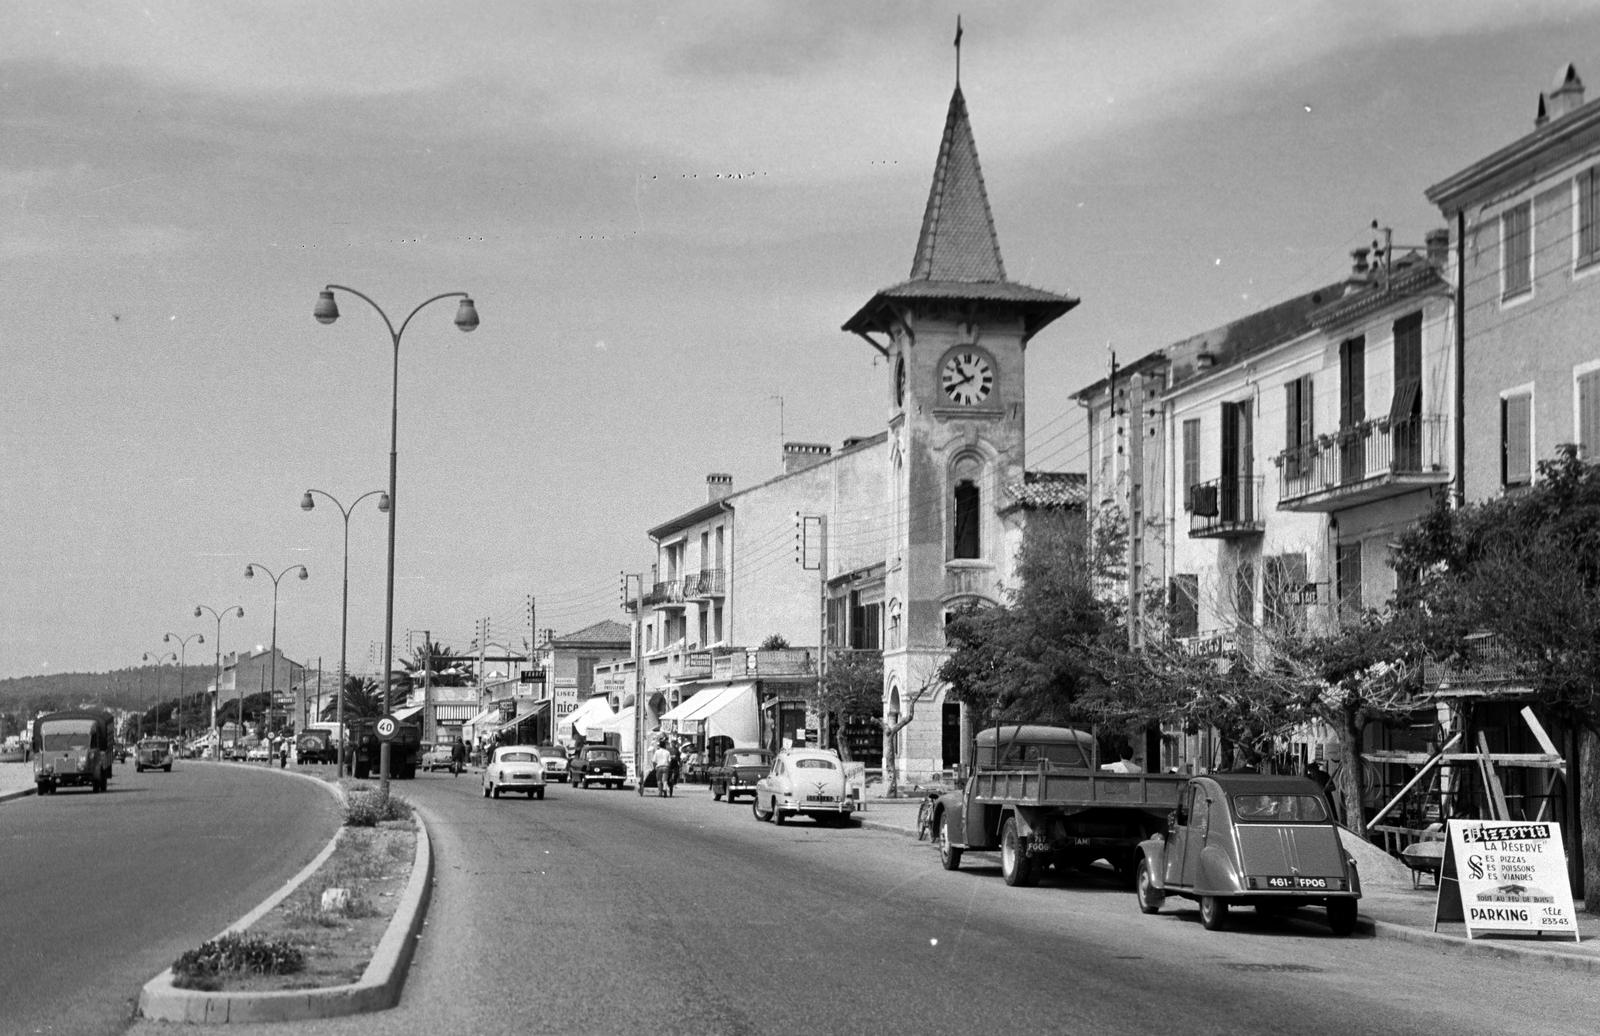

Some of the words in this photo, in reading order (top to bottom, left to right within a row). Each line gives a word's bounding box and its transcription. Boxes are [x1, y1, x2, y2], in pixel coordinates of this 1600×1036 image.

[557, 701, 579, 713] nice
[379, 722, 393, 732] 40
[1463, 823, 1549, 843] Pizzeria
[1484, 841, 1498, 852] LA
[1500, 855, 1527, 864] PIZZAS
[1501, 865, 1536, 873] POISSONS
[1502, 873, 1533, 881] VIANDES
[1300, 878, 1326, 888] FP06
[1470, 908, 1528, 921] PARKING
